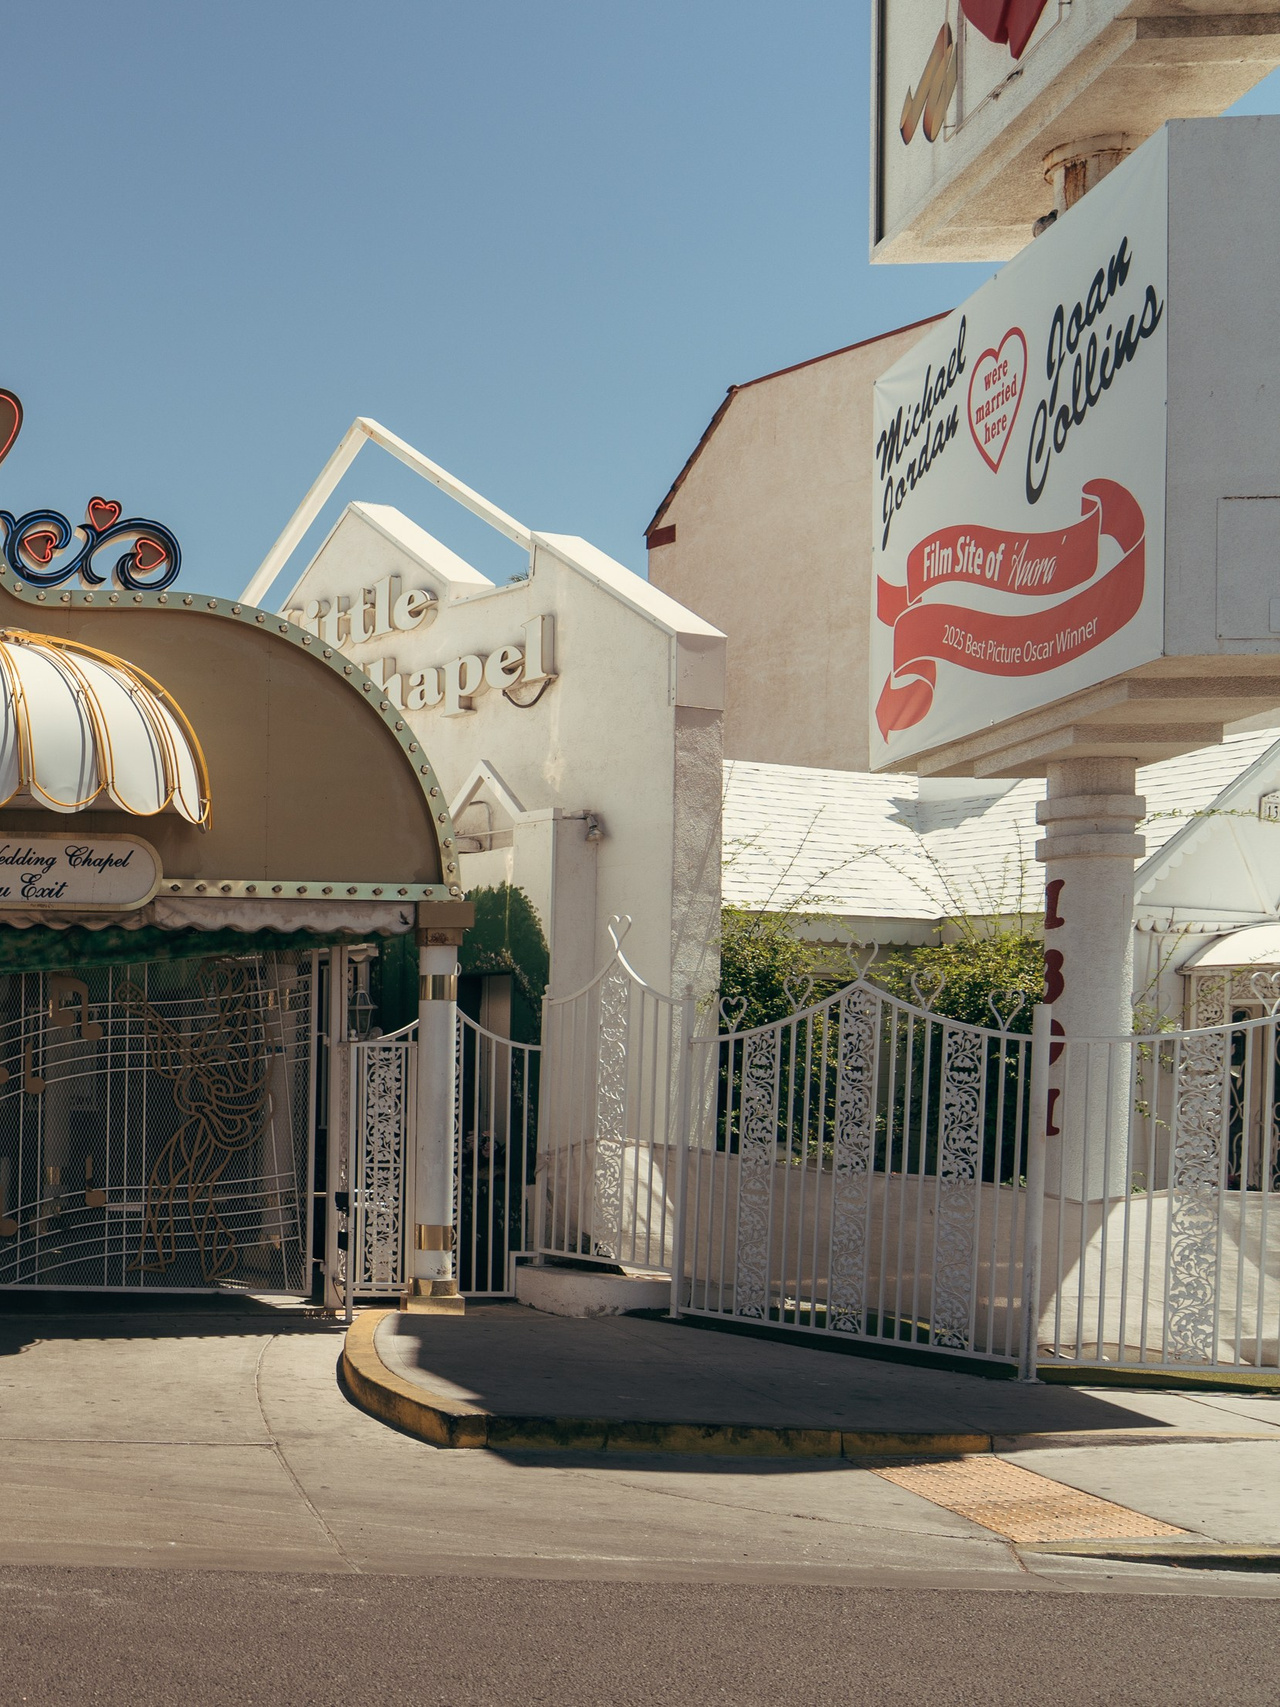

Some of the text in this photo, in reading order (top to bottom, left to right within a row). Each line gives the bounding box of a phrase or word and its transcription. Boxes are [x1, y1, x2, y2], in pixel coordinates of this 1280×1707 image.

[1045, 235, 1133, 418] Joan
[876, 314, 967, 481] Michael
[975, 373, 1018, 425] married
[984, 359, 1008, 392] were
[1025, 284, 1164, 505] Collins
[984, 413, 1008, 445] here
[881, 404, 959, 552] Jordan
[923, 540, 953, 582] Film
[954, 535, 984, 575] Site
[985, 542, 1006, 582] of
[942, 616, 1098, 664] 2025 Best Picture Oscar Winner
[360, 615, 556, 718] hapel
[64, 844, 134, 874] Chapel
[20, 872, 69, 900] Exit
